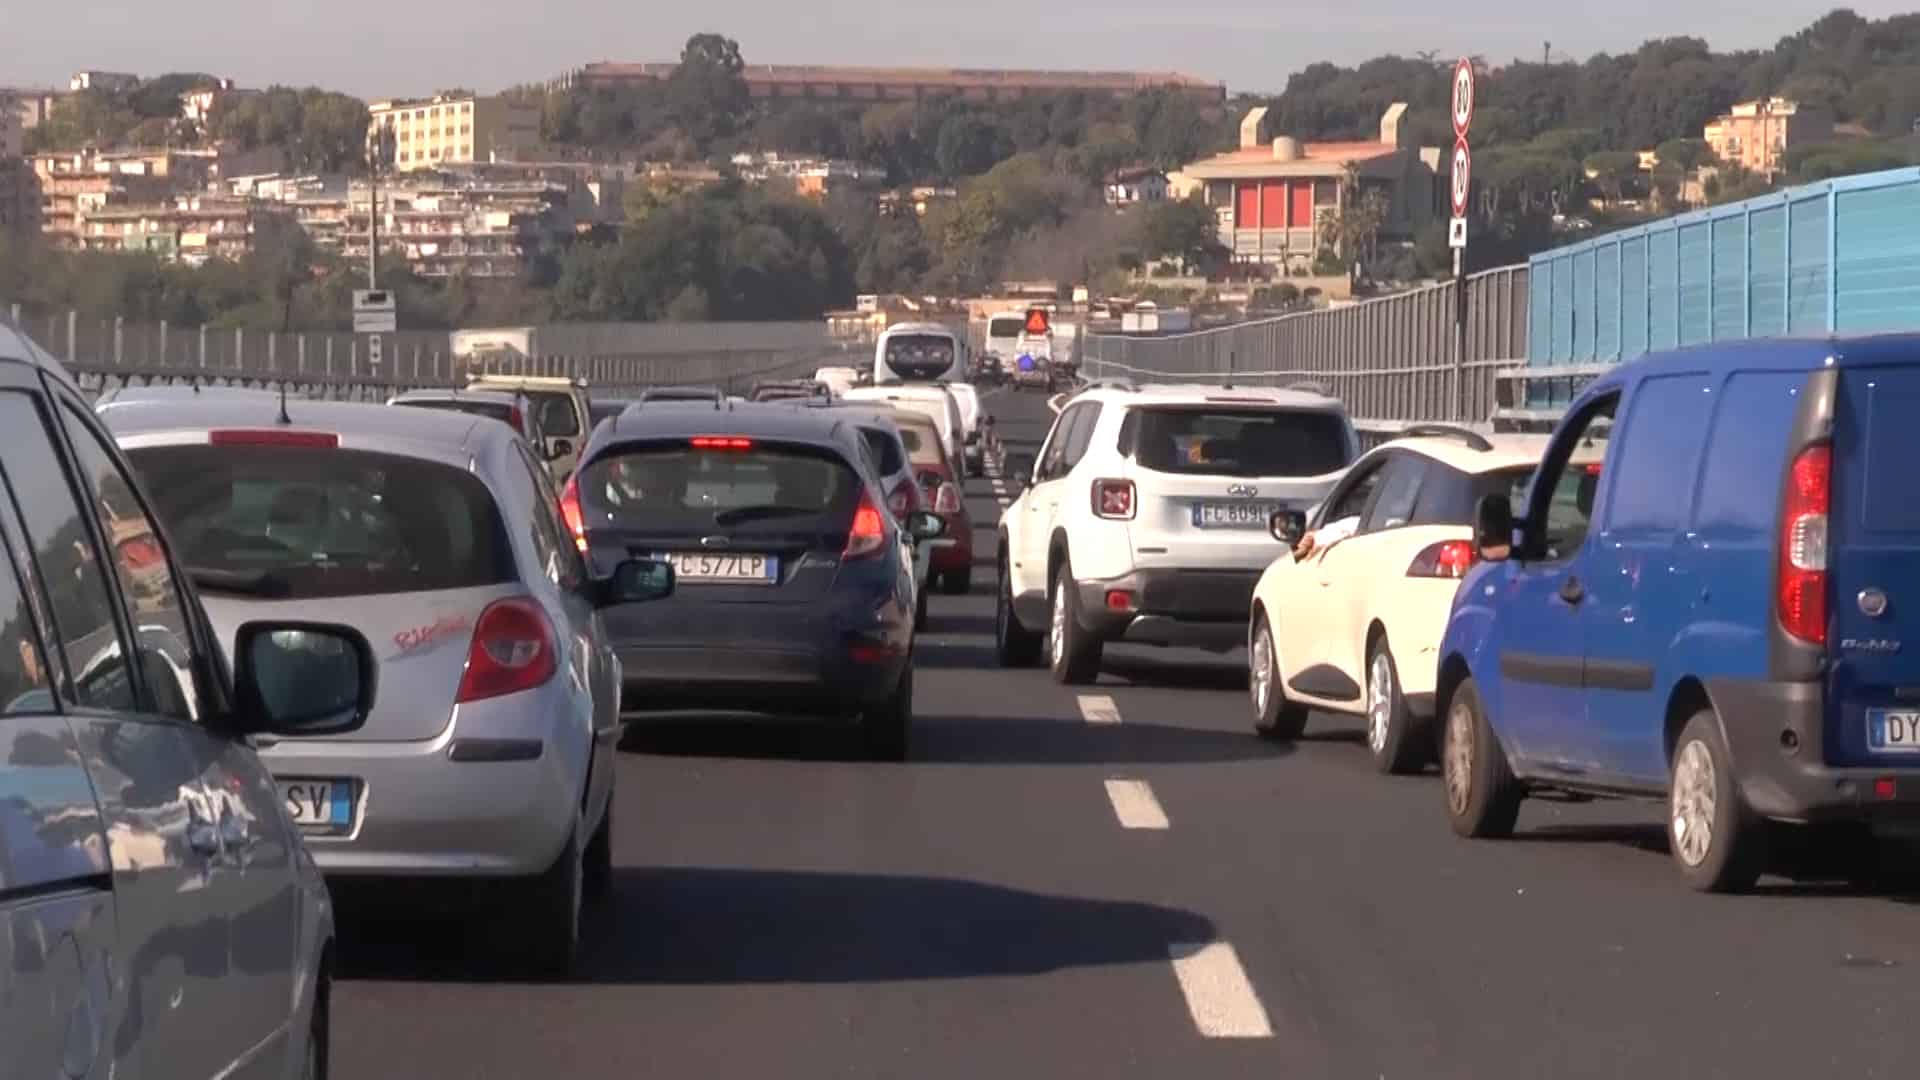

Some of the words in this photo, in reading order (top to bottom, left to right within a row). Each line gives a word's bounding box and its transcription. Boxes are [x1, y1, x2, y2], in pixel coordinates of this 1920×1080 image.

[1457, 79, 1469, 114] 80
[701, 555, 762, 575] 577LP
[1889, 715, 1920, 743] DY
[288, 784, 326, 819] SV
